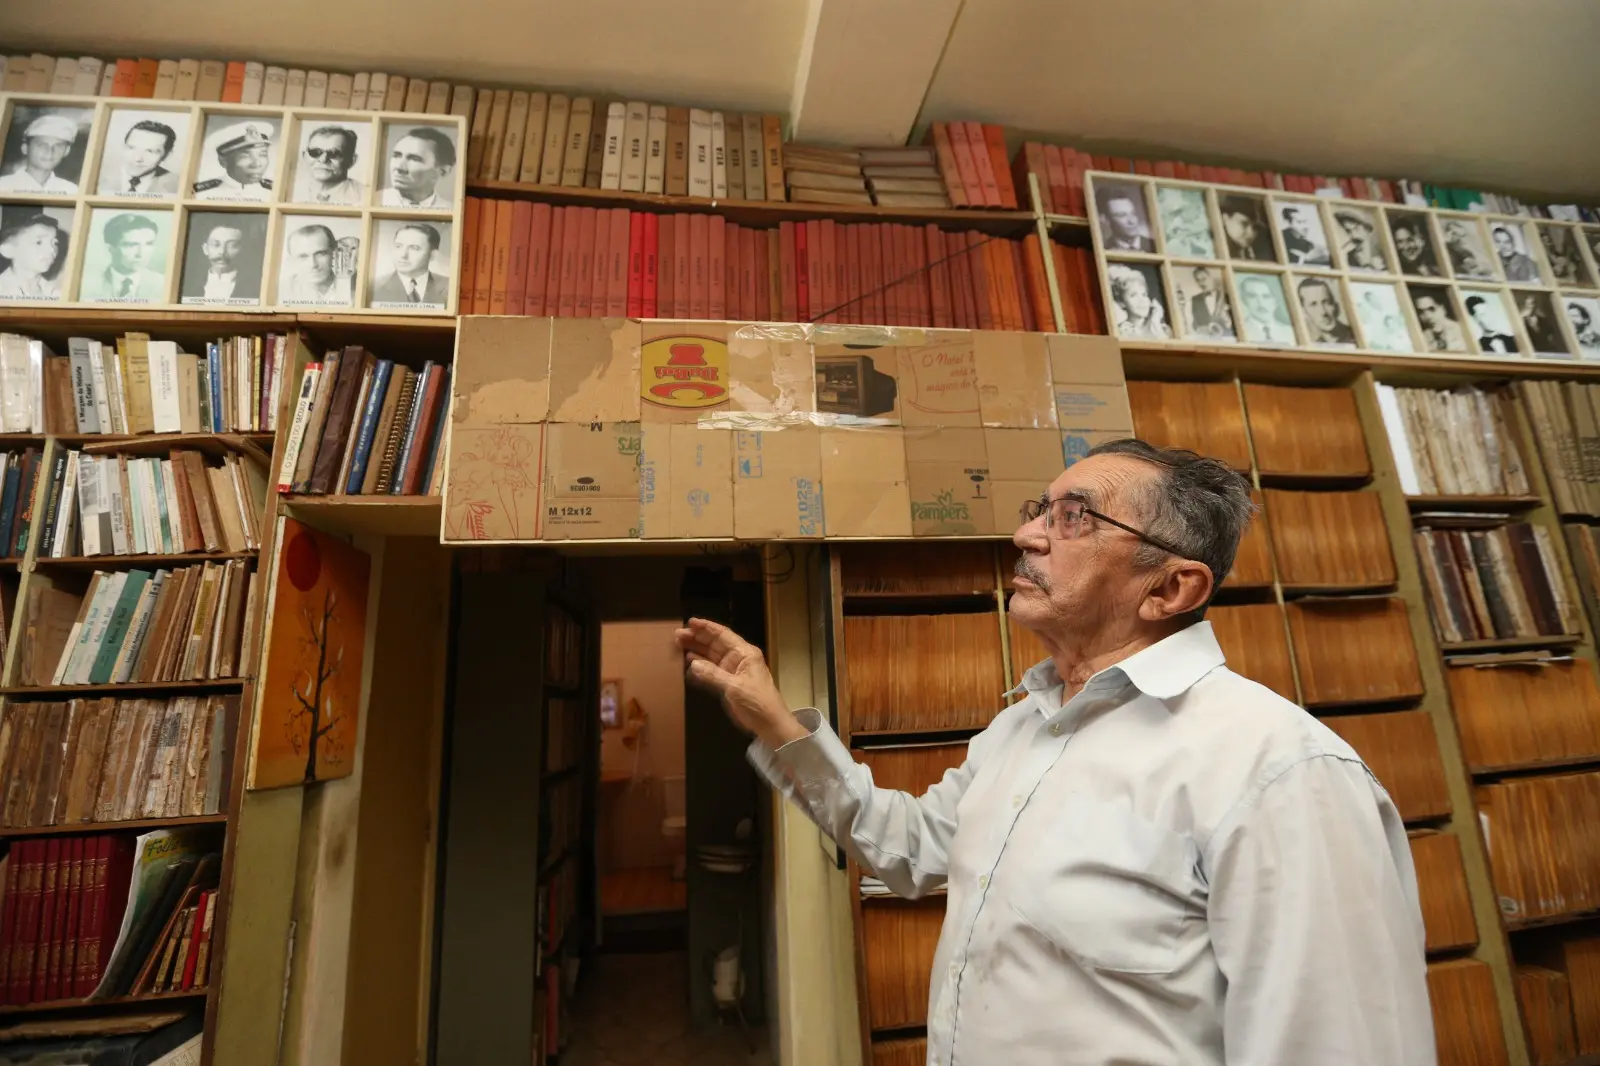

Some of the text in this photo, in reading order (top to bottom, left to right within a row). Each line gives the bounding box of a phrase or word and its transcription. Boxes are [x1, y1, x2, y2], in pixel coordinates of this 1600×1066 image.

[608, 136, 617, 156] VEJA
[632, 138, 640, 158] VEJA
[590, 422, 603, 432] M
[548, 507, 592, 516] M 12x12
[911, 502, 970, 522] Pampers
